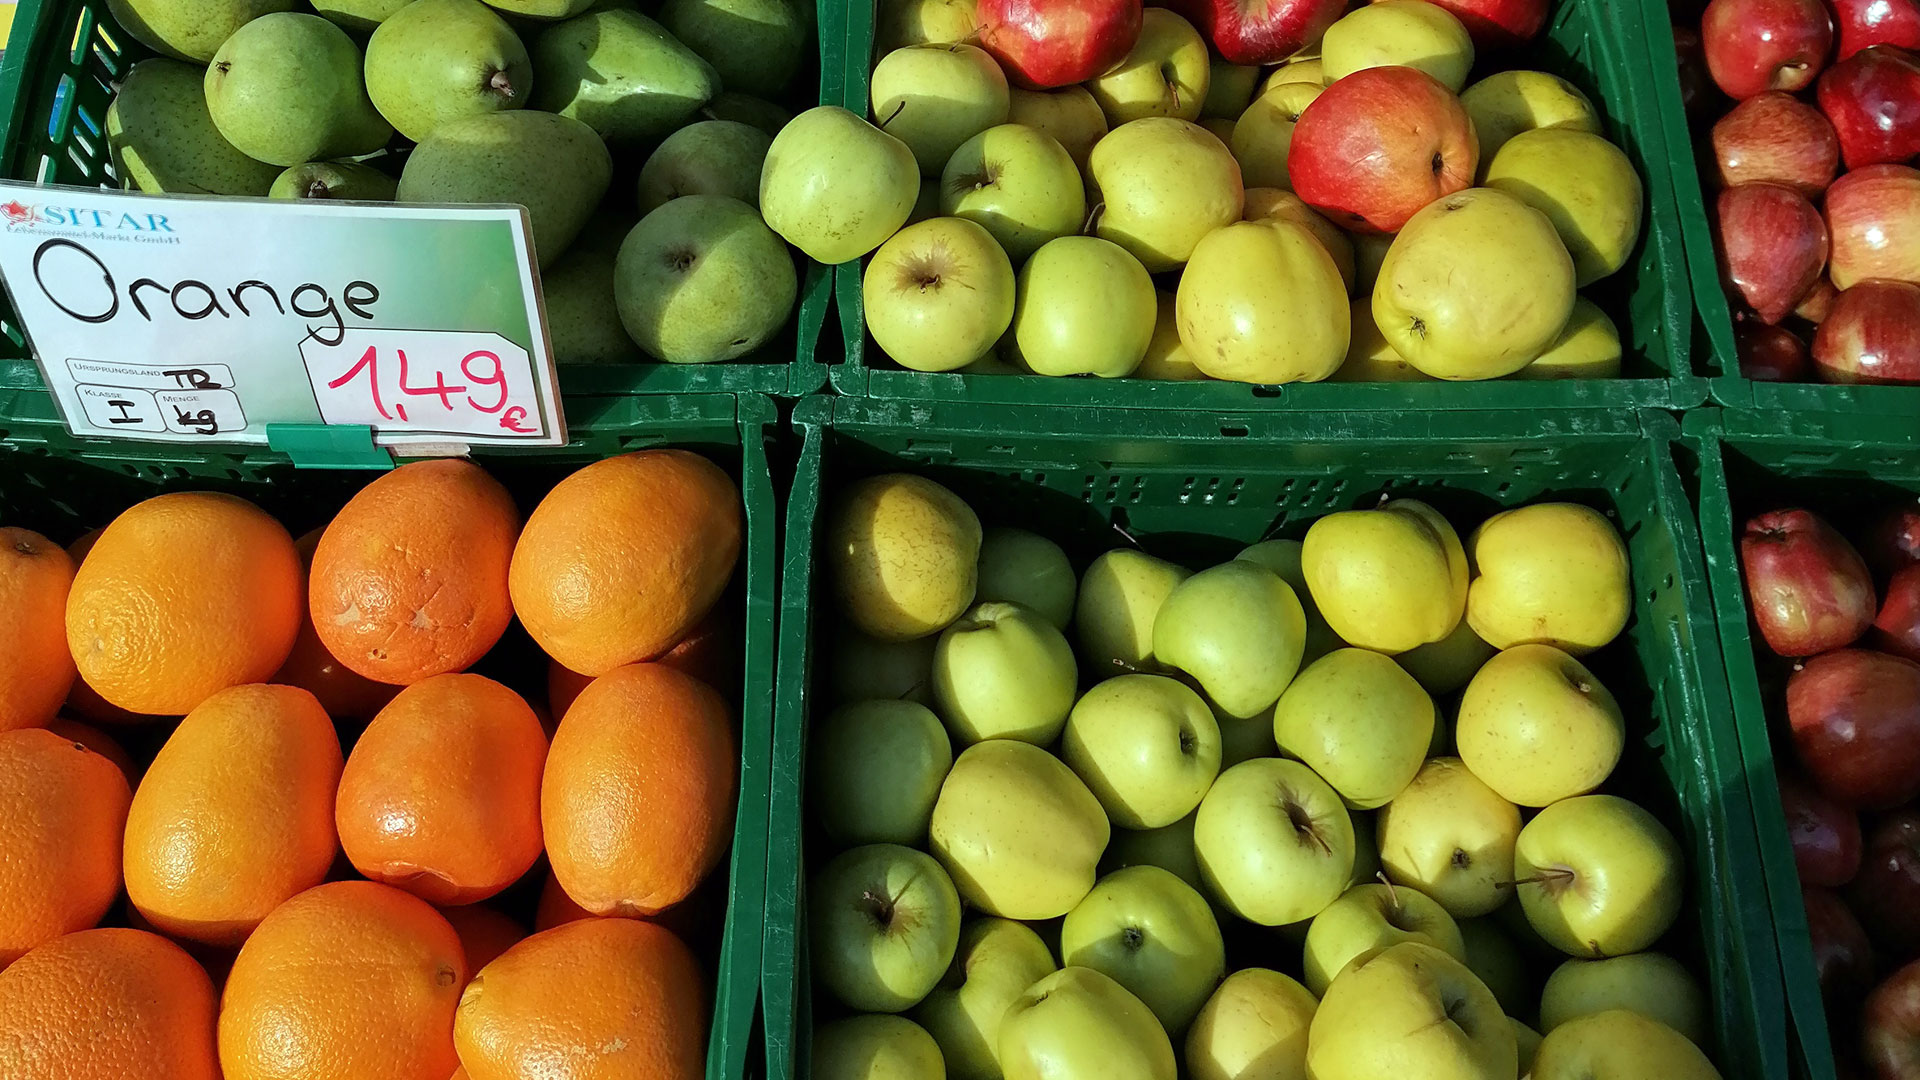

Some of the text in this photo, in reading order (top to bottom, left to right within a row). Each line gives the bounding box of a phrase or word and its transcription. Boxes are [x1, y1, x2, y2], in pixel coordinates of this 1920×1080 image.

[44, 205, 175, 232] SITAR
[134, 234, 181, 244] GmbH
[33, 238, 380, 346] Orange
[328, 345, 538, 433] 1,49 €
[107, 400, 143, 424] I
[172, 404, 219, 435] kg
